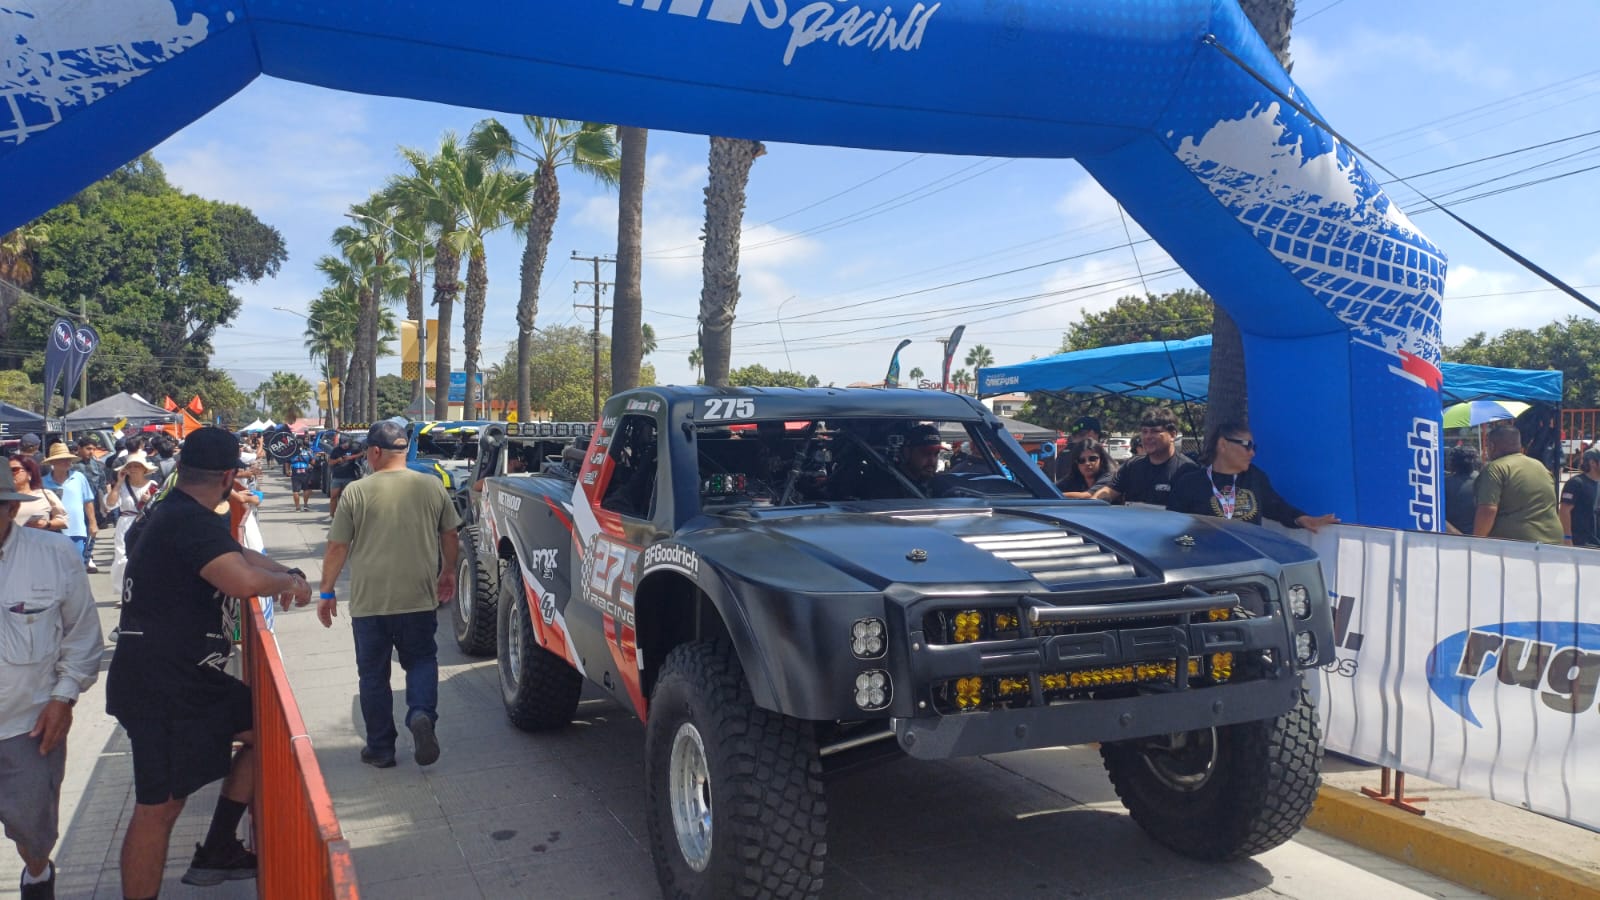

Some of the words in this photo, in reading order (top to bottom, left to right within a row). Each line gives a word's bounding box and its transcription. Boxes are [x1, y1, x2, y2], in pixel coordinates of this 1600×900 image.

[703, 397, 756, 420] 275
[532, 548, 559, 570] FOX
[643, 543, 699, 573] BFGoodrich
[1457, 630, 1600, 714] rug
